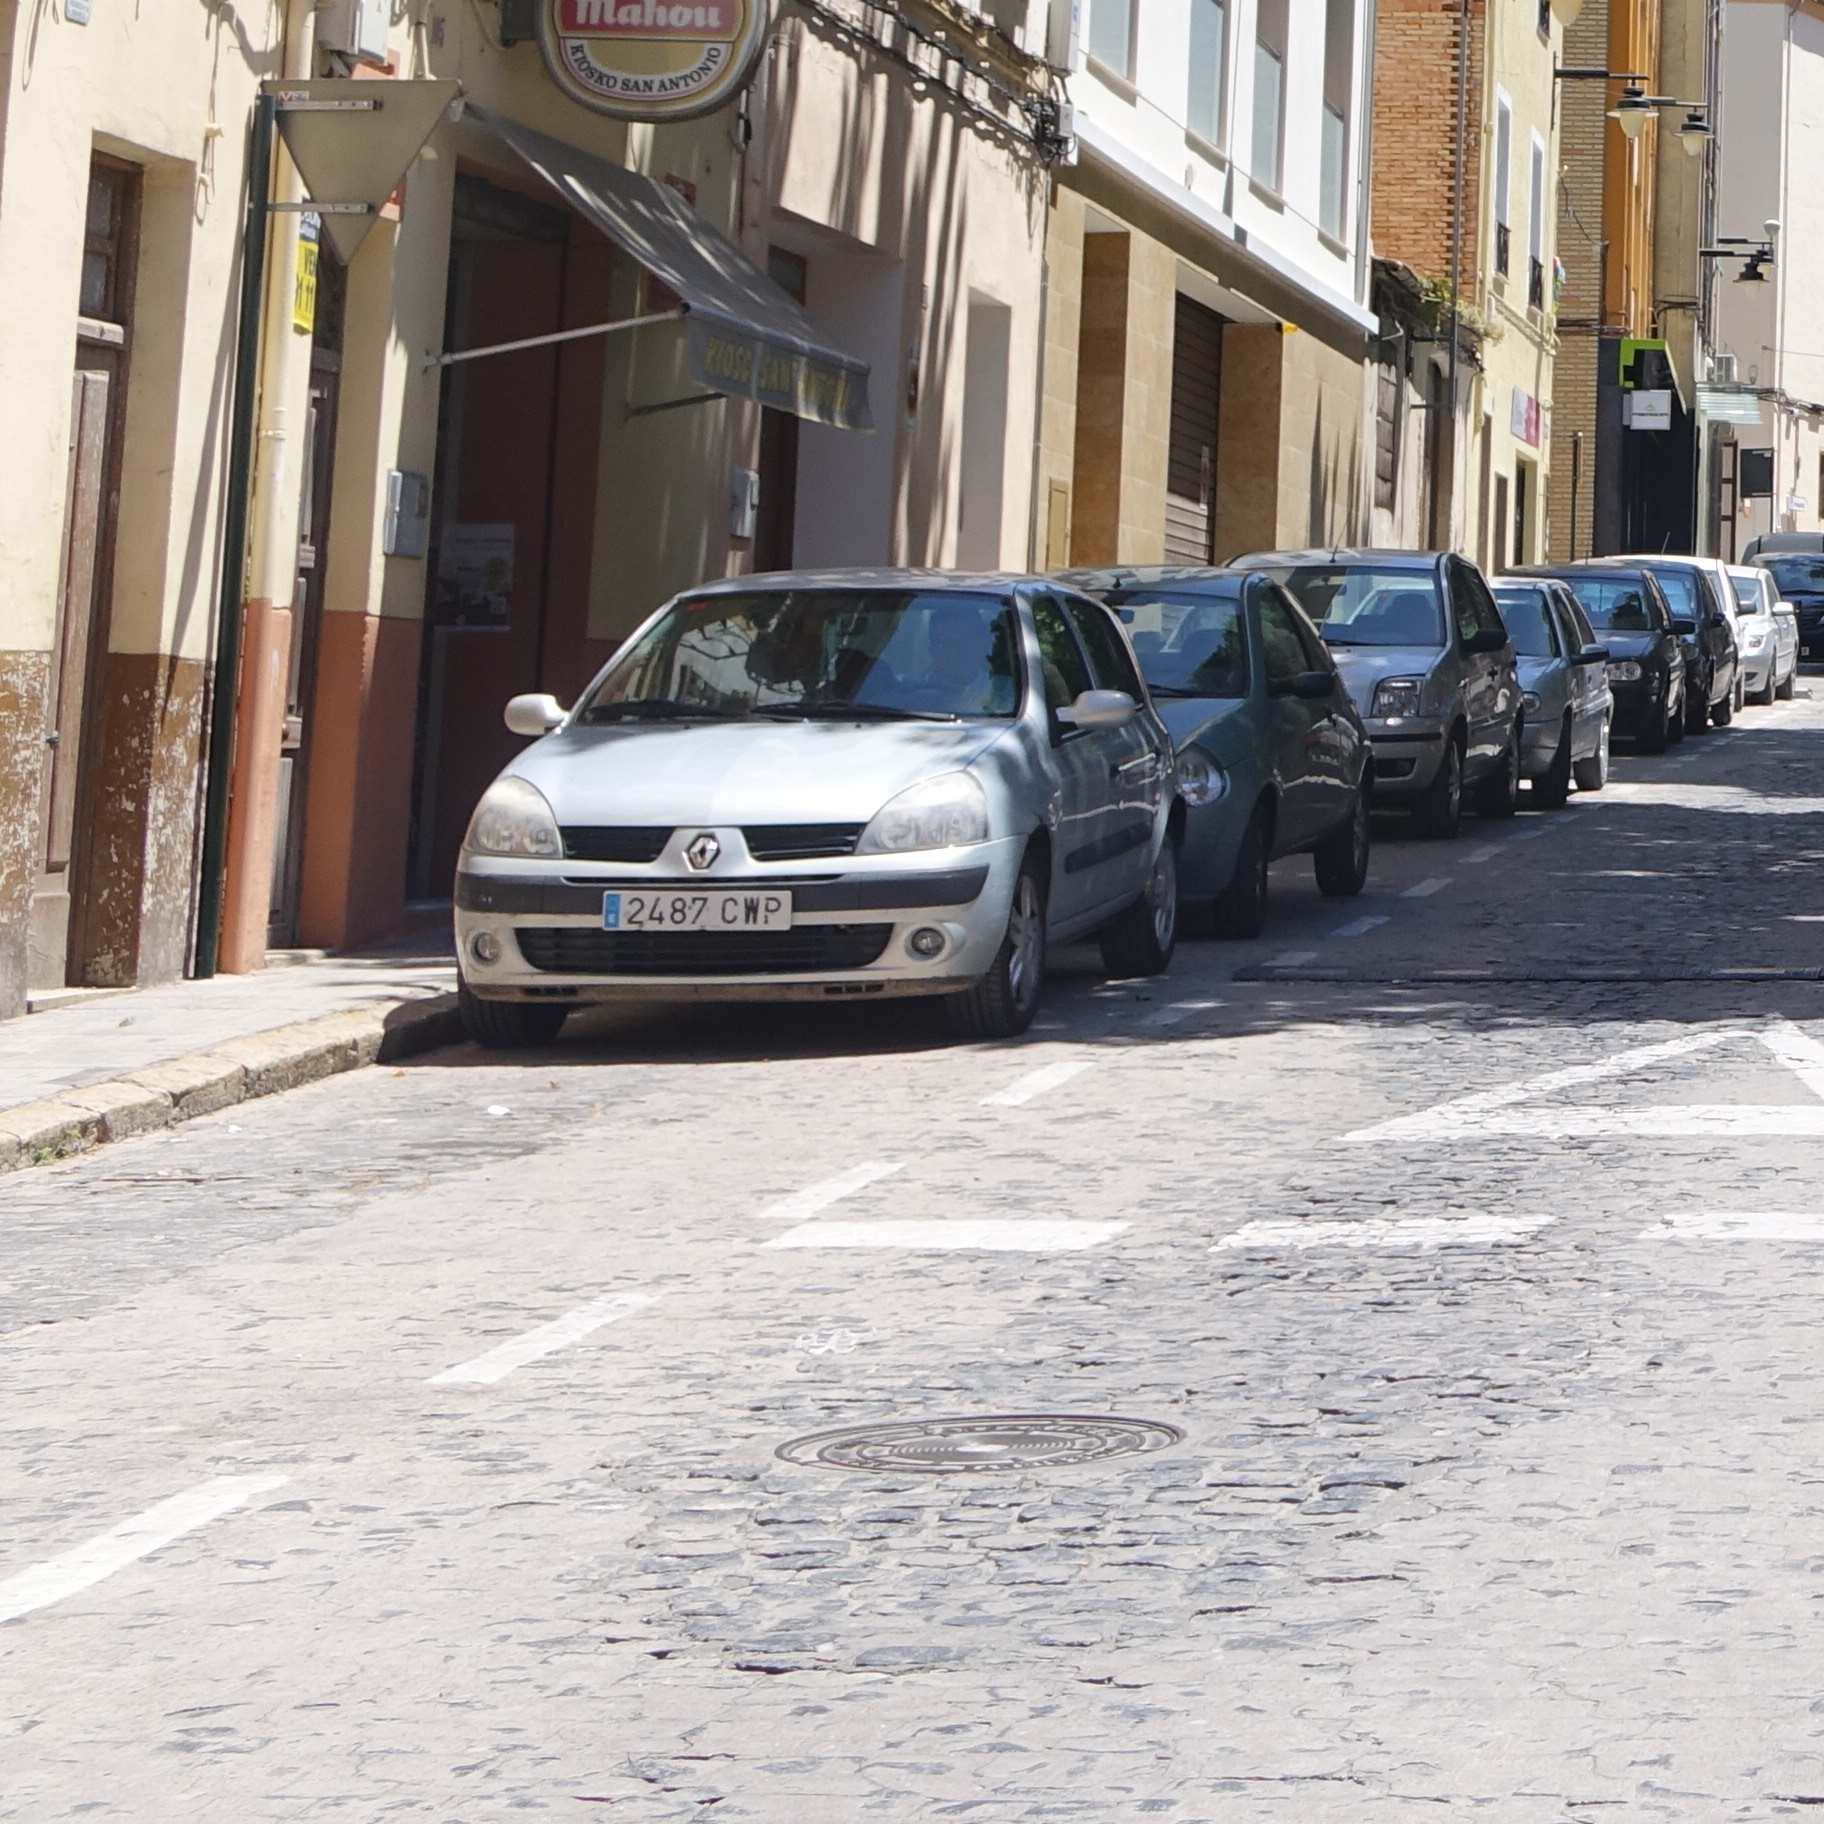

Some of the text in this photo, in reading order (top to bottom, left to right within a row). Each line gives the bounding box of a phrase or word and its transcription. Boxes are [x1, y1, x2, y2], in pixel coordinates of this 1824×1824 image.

[570, 43, 721, 93] KIOSKO SAN ANTONIO
[627, 896, 782, 925] 2487 CWP
